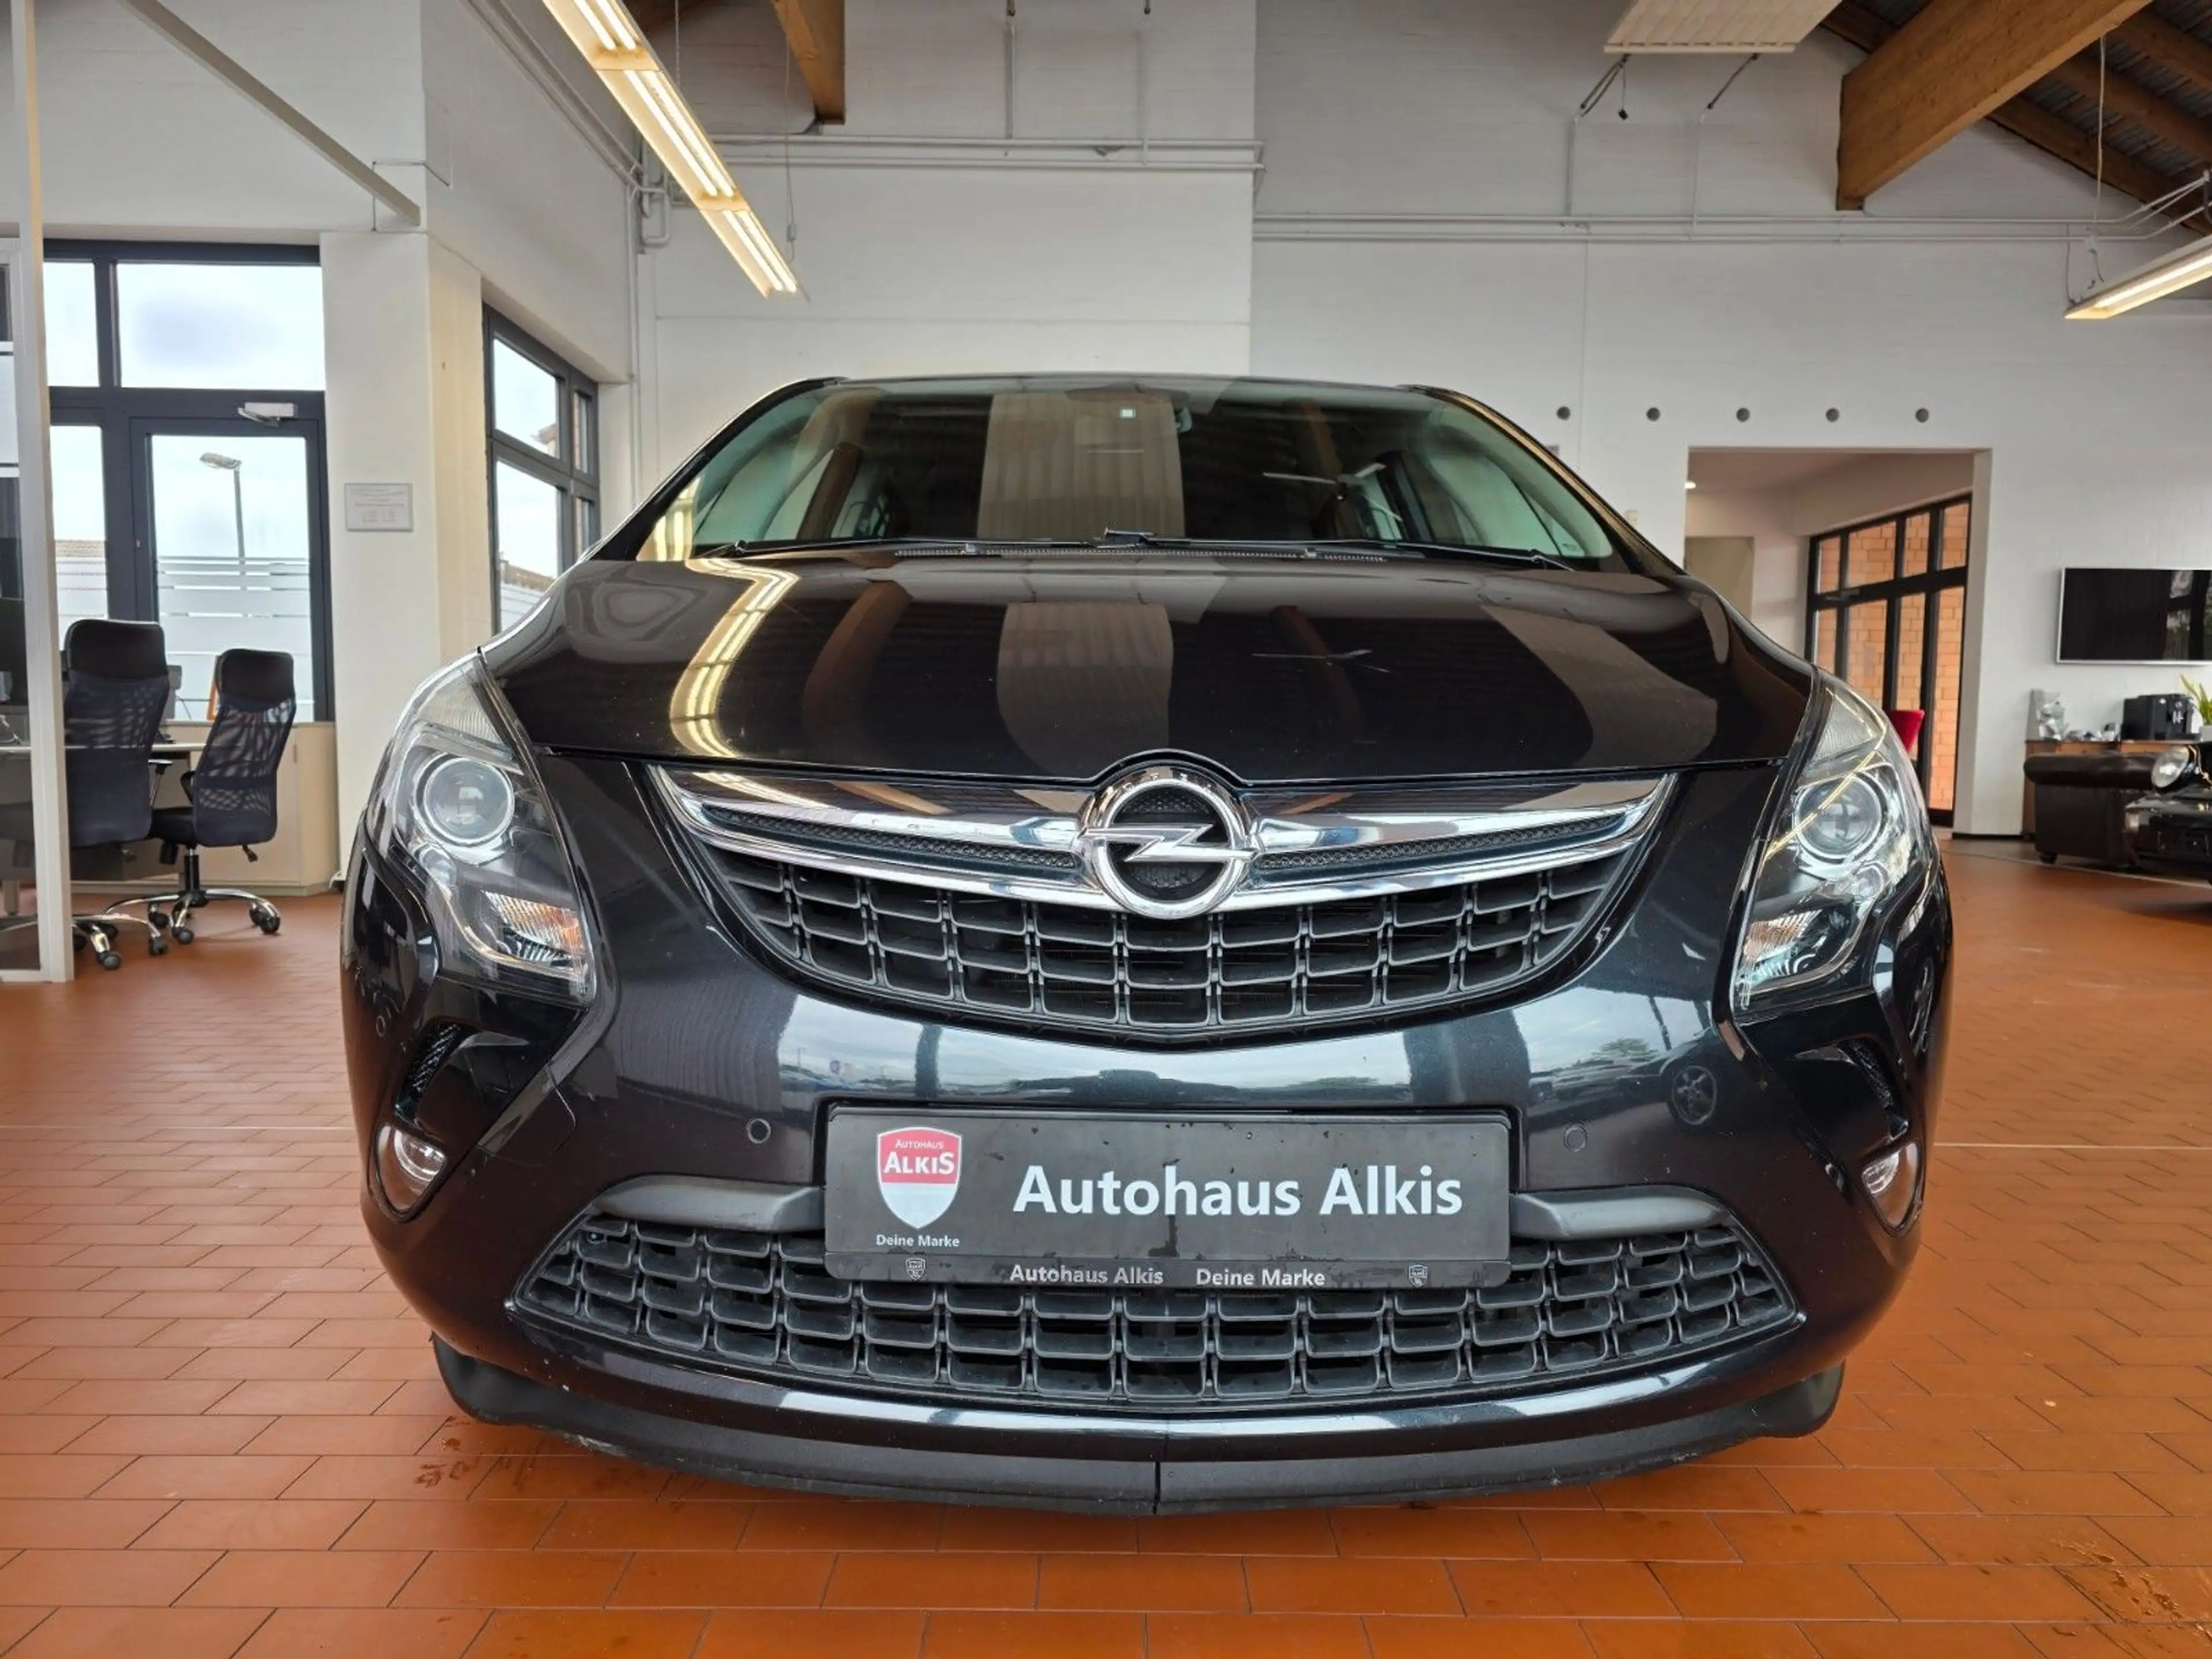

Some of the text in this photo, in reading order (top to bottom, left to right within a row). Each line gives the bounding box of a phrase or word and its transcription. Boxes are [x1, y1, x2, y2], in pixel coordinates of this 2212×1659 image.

[884, 1152, 955, 1175] ALKIS
[1012, 1165, 1463, 1215] Autohaus Alkis
[876, 1234, 960, 1247] Deine Marke
[1010, 1264, 1164, 1285] Autohaus Alkis
[1196, 1268, 1325, 1286] Deine Marke
